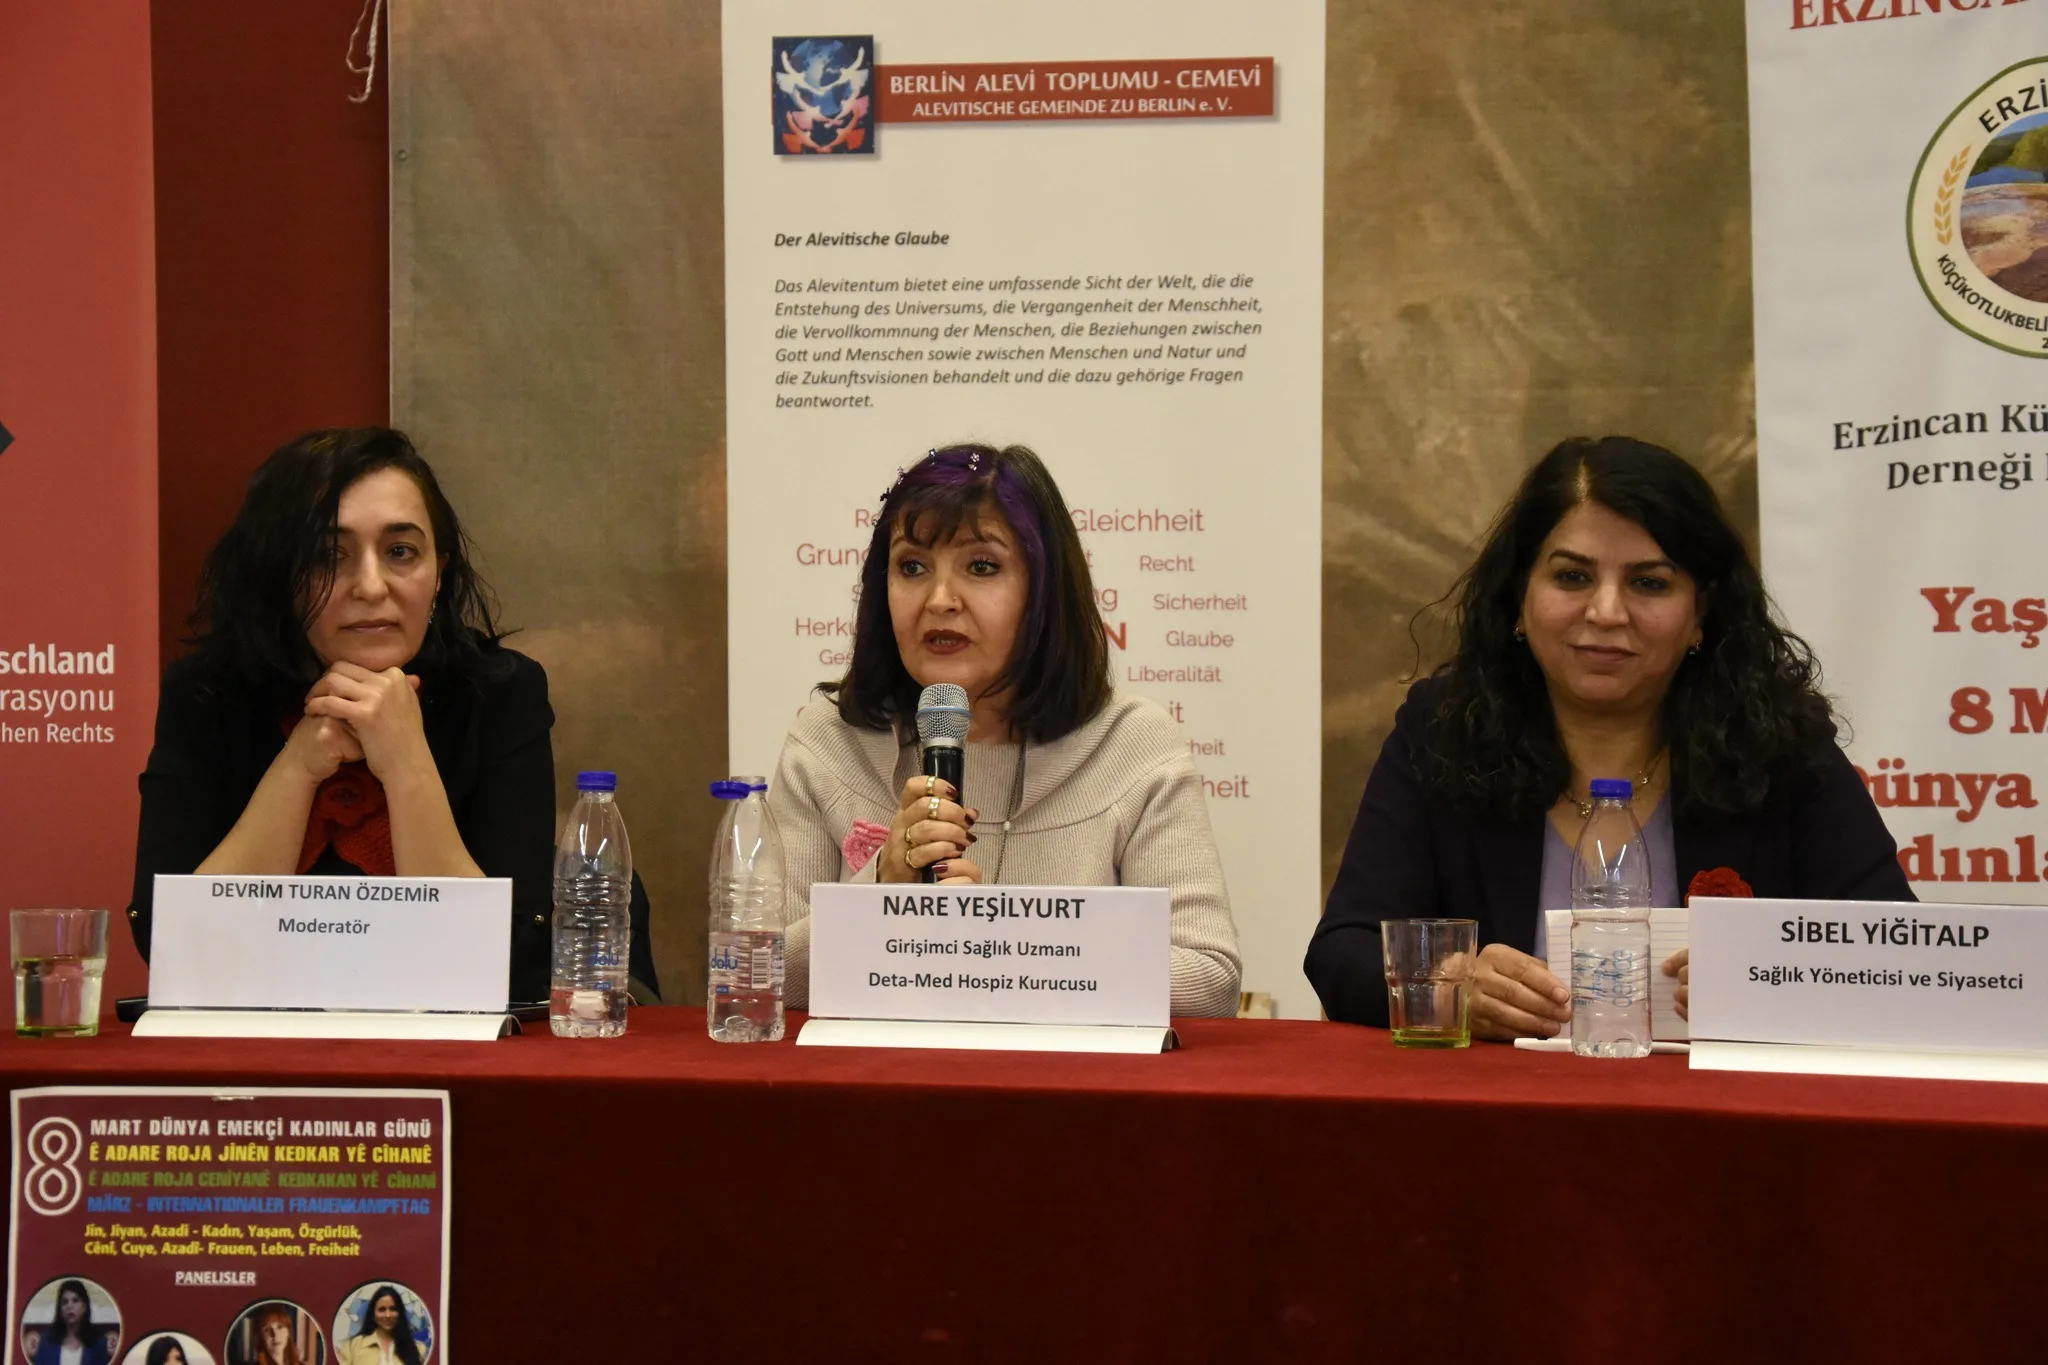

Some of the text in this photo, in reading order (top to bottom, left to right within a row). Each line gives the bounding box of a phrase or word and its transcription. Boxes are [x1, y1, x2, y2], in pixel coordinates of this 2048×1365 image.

[891, 71, 965, 93] BERLİN
[975, 69, 1035, 92] ALEVİ
[1045, 71, 1158, 90] TOPLUMU
[1177, 65, 1260, 88] CEMEVİ
[913, 97, 1232, 116] ALEVITISCHE GEMEINDE ZU BERLIN e. V.
[775, 231, 949, 246] Der Alevitische Glaube
[775, 274, 1253, 294] Das Alevitentum bietet eine umfassende Sicht der Welt, die die
[775, 297, 1262, 318] Entstehung des Universums, die Vergangenheit der Menschheit,
[775, 321, 1262, 341] die Vervollkommnung der Menschen, die Beziehungen zwischen
[776, 344, 1246, 362] Gott und Menschen sowie zwischen Menschen und Natur und
[776, 368, 1243, 387] die Zukunftsvisionen behandelt und die dazu gehörige Fragen
[776, 394, 873, 408] beantwortet.
[1834, 412, 1988, 450] Erzincan
[1888, 453, 2032, 490] Derneği
[1069, 509, 1204, 532] Gleichheit
[1140, 555, 1194, 571] Recht
[1154, 594, 1247, 610] Sicherheit
[1166, 631, 1234, 647] Glaube
[1128, 666, 1221, 682] Liberalität
[1949, 687, 1993, 734] 8
[47, 722, 114, 742] Rechts
[212, 880, 439, 902] DEVRİM TURAN ÖZDEMİR
[884, 893, 1085, 922] NARE YEŞİLYURT
[279, 918, 370, 934] Moderatör
[1782, 916, 1989, 947] SİBEL YİĞİTALP
[886, 939, 1080, 958] Girişimci Sağlık Uzmanı
[870, 973, 1096, 992] Deta-Med Hospiz Kurucusu
[1749, 966, 2022, 991] Sağlık Yöneticisi ve Siyasetci
[91, 1117, 431, 1140] MART DÜNYA EMEKÇİ KADINLAR GÜNÜ
[105, 1145, 160, 1161] ADARE
[166, 1145, 212, 1161] ROJA
[275, 1146, 339, 1162] KEDKAR
[347, 1143, 366, 1162] YÊ
[24, 1117, 82, 1216] 8
[102, 1172, 149, 1187] ADARE
[153, 1172, 193, 1186] ROJA
[147, 1197, 284, 1213] INTERNATIONALER
[289, 1197, 430, 1214] FRAUENKAMPFTAG
[202, 1224, 244, 1238] Kadın,
[248, 1225, 294, 1239] Yaşam,
[299, 1223, 361, 1241] Özgürlük,
[208, 1242, 257, 1256] Frauen,
[261, 1242, 304, 1256] Leben,
[309, 1242, 360, 1256] Freiheit
[176, 1271, 256, 1285] PANELISLER
